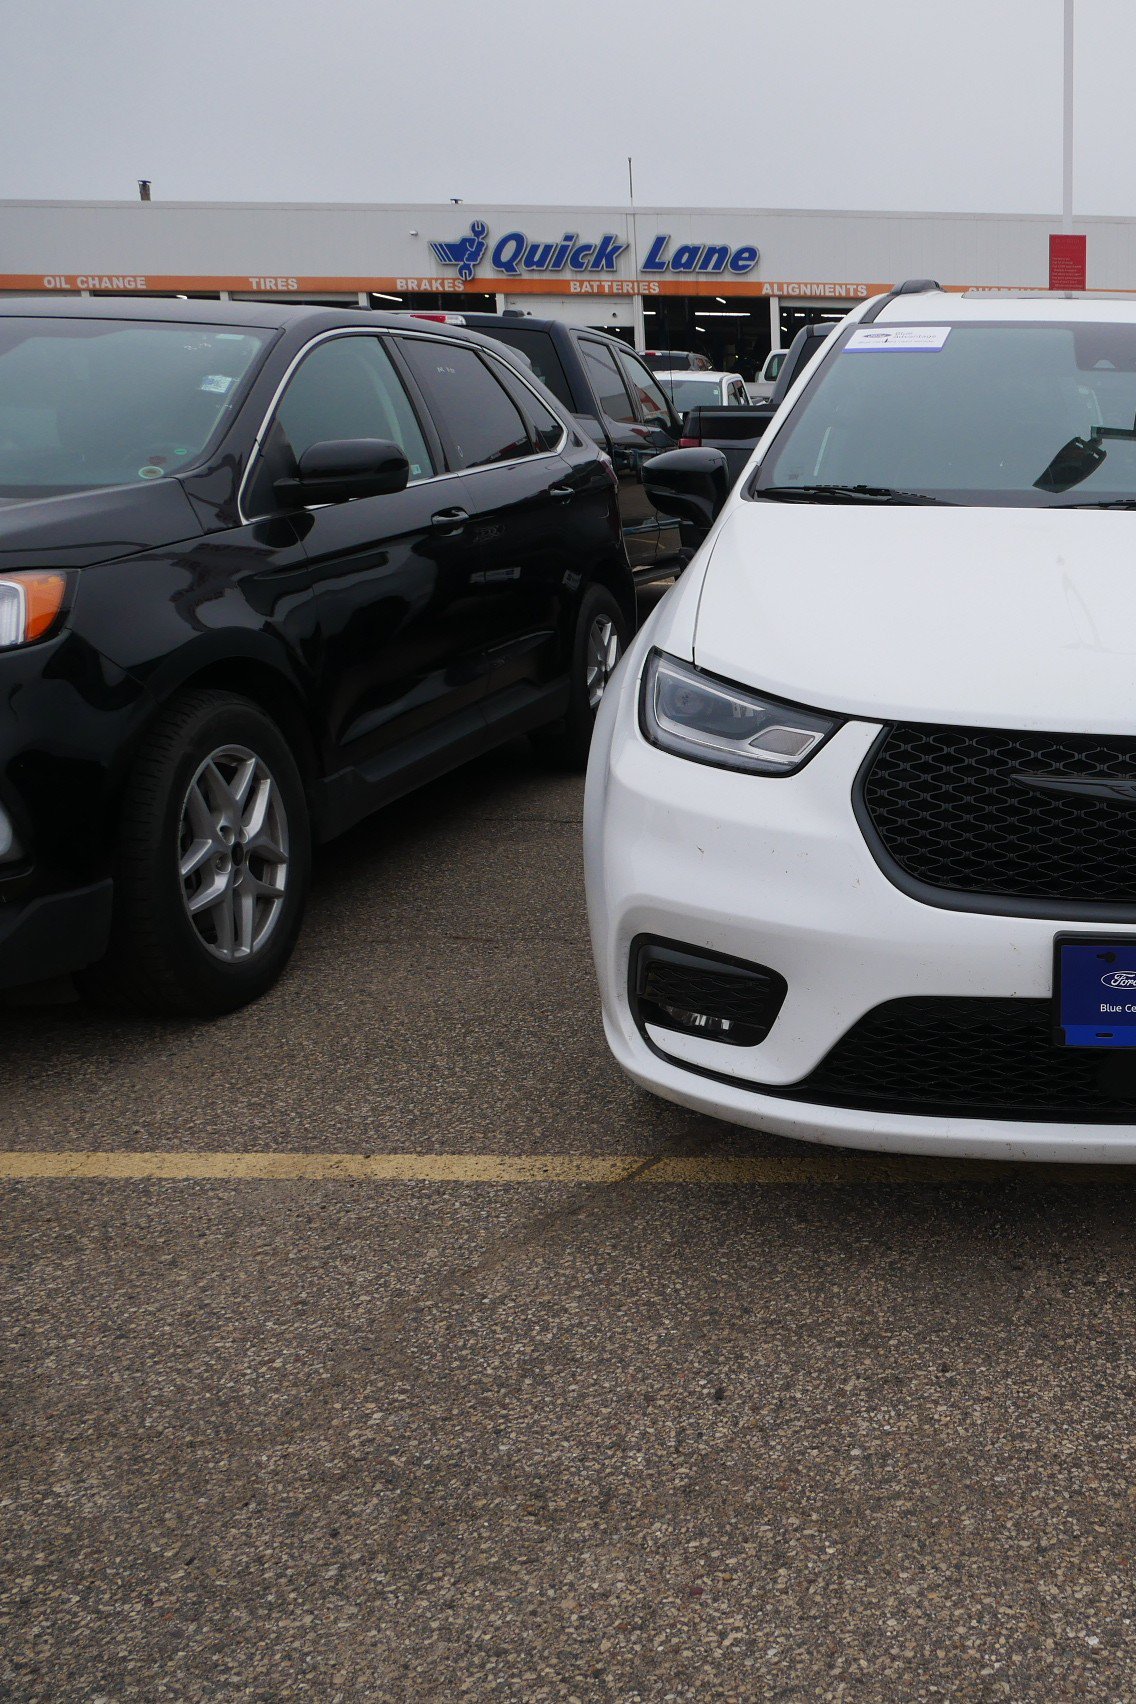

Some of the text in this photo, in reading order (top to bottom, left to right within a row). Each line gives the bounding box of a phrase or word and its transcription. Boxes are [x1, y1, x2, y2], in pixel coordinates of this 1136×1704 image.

[491, 230, 760, 275] Quick Lane
[43, 276, 147, 290] OIL CHANGE
[249, 277, 298, 291] TIRES
[396, 278, 465, 292] BRAKES
[570, 280, 660, 294] BATTERIES
[761, 282, 868, 297] ALIGNMENTS
[1100, 1003, 1122, 1013] Blue
